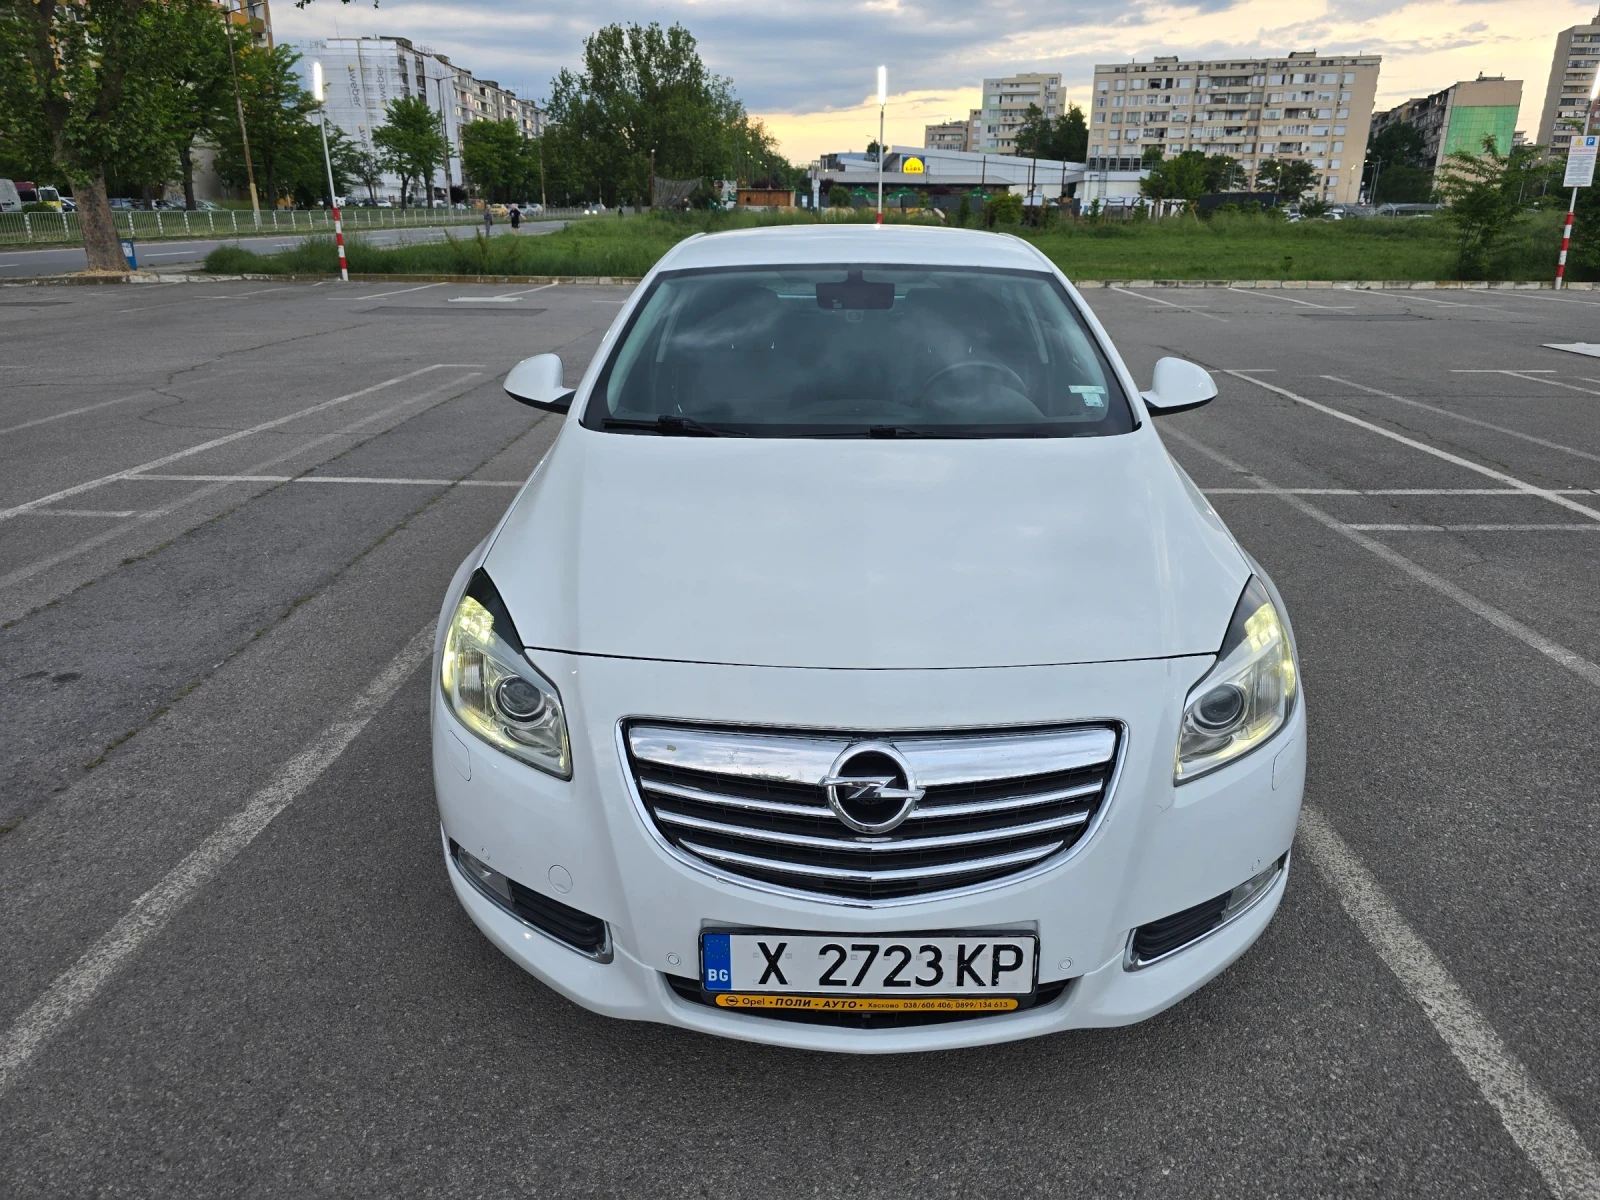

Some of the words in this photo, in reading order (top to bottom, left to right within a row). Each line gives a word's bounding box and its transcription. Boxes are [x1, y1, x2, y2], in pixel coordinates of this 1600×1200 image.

[349, 71, 361, 107] weber
[376, 64, 386, 100] weber
[708, 969, 728, 981] BG
[818, 944, 944, 986] 2723
[742, 998, 765, 1006] Opel
[775, 999, 811, 1007] ПОЛИ
[822, 1001, 857, 1009] АУТО
[903, 1001, 935, 1009] 038/606
[937, 1001, 953, 1009] 406;
[955, 1000, 992, 1009] 0899/134
